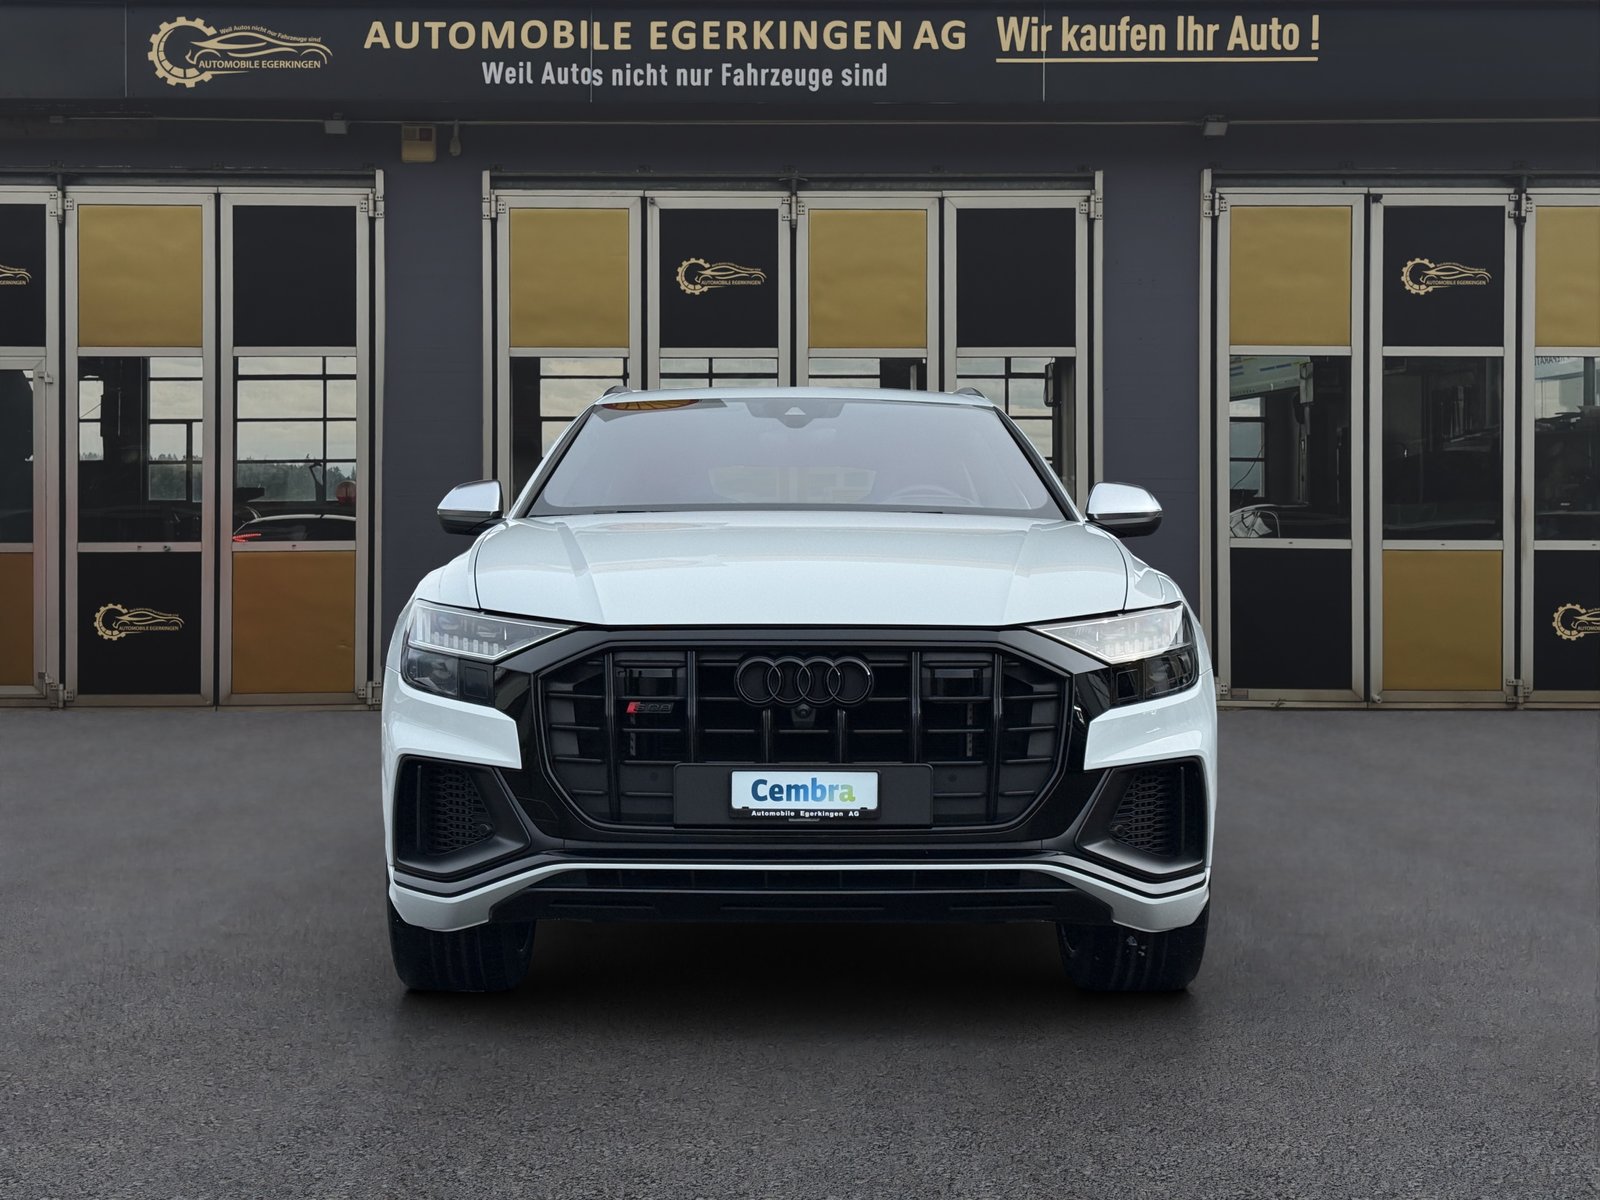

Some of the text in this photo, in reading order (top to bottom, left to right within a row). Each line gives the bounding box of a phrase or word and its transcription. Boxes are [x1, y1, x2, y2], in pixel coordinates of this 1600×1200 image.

[219, 26, 233, 35] Weil
[251, 25, 267, 33] nicht
[277, 32, 307, 43] Fahrzeuge
[363, 20, 967, 50] AUTOMOBILE EGERKINGEN AG
[996, 14, 1320, 51] Wir kaufen Ihr Auto !
[198, 60, 321, 69] AUTOMOBILE EGERKINGEN
[481, 61, 888, 92] Weil Autos nicht nur Fahrzeuge sind
[751, 777, 856, 802] Cembra
[800, 810, 844, 818] Egerkingen
